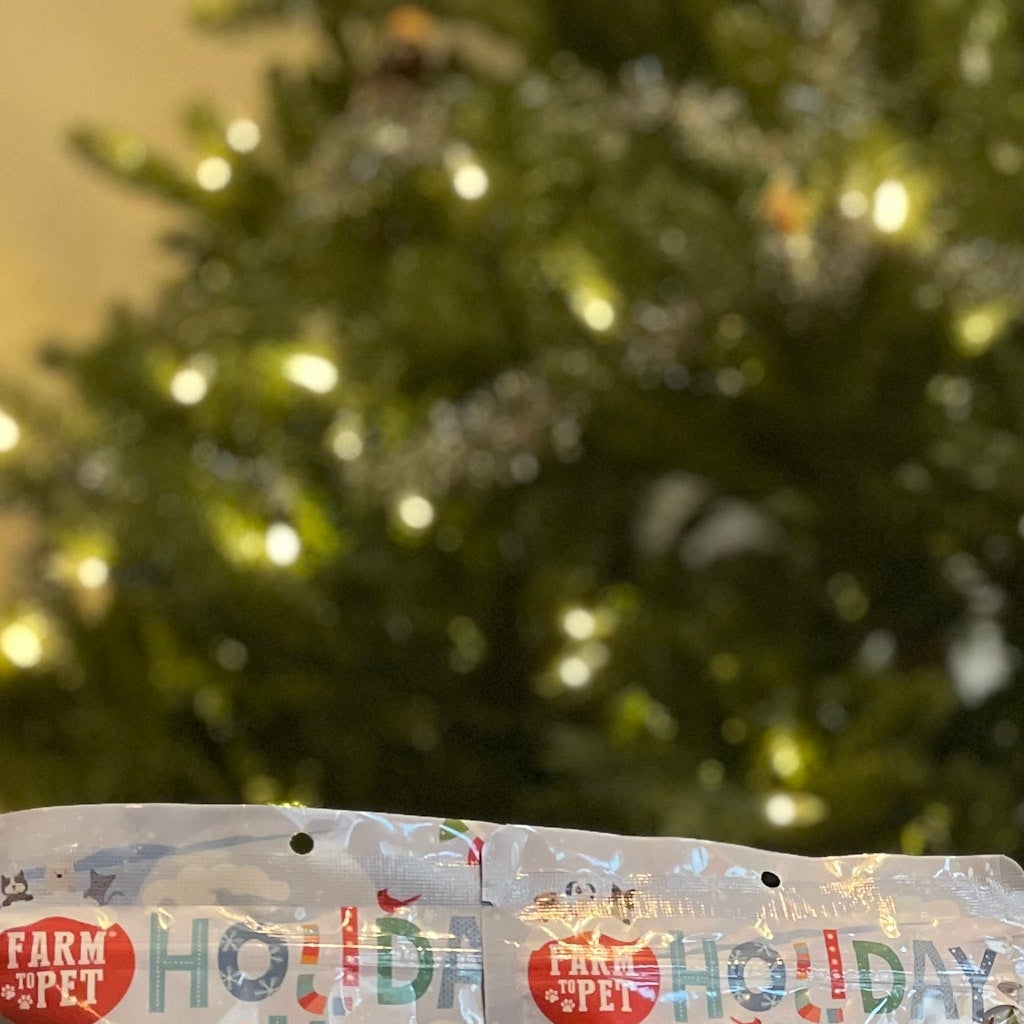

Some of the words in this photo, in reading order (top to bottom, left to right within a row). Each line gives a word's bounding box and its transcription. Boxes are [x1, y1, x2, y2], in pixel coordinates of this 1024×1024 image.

[7, 931, 107, 969] FARM
[148, 906, 482, 1015] HOLIDA
[549, 944, 638, 976] FARM
[16, 972, 35, 990] TO
[37, 969, 104, 1009] PET
[558, 979, 576, 994] TO
[577, 979, 637, 1012] PET
[669, 929, 998, 1024] HOLIDAY
